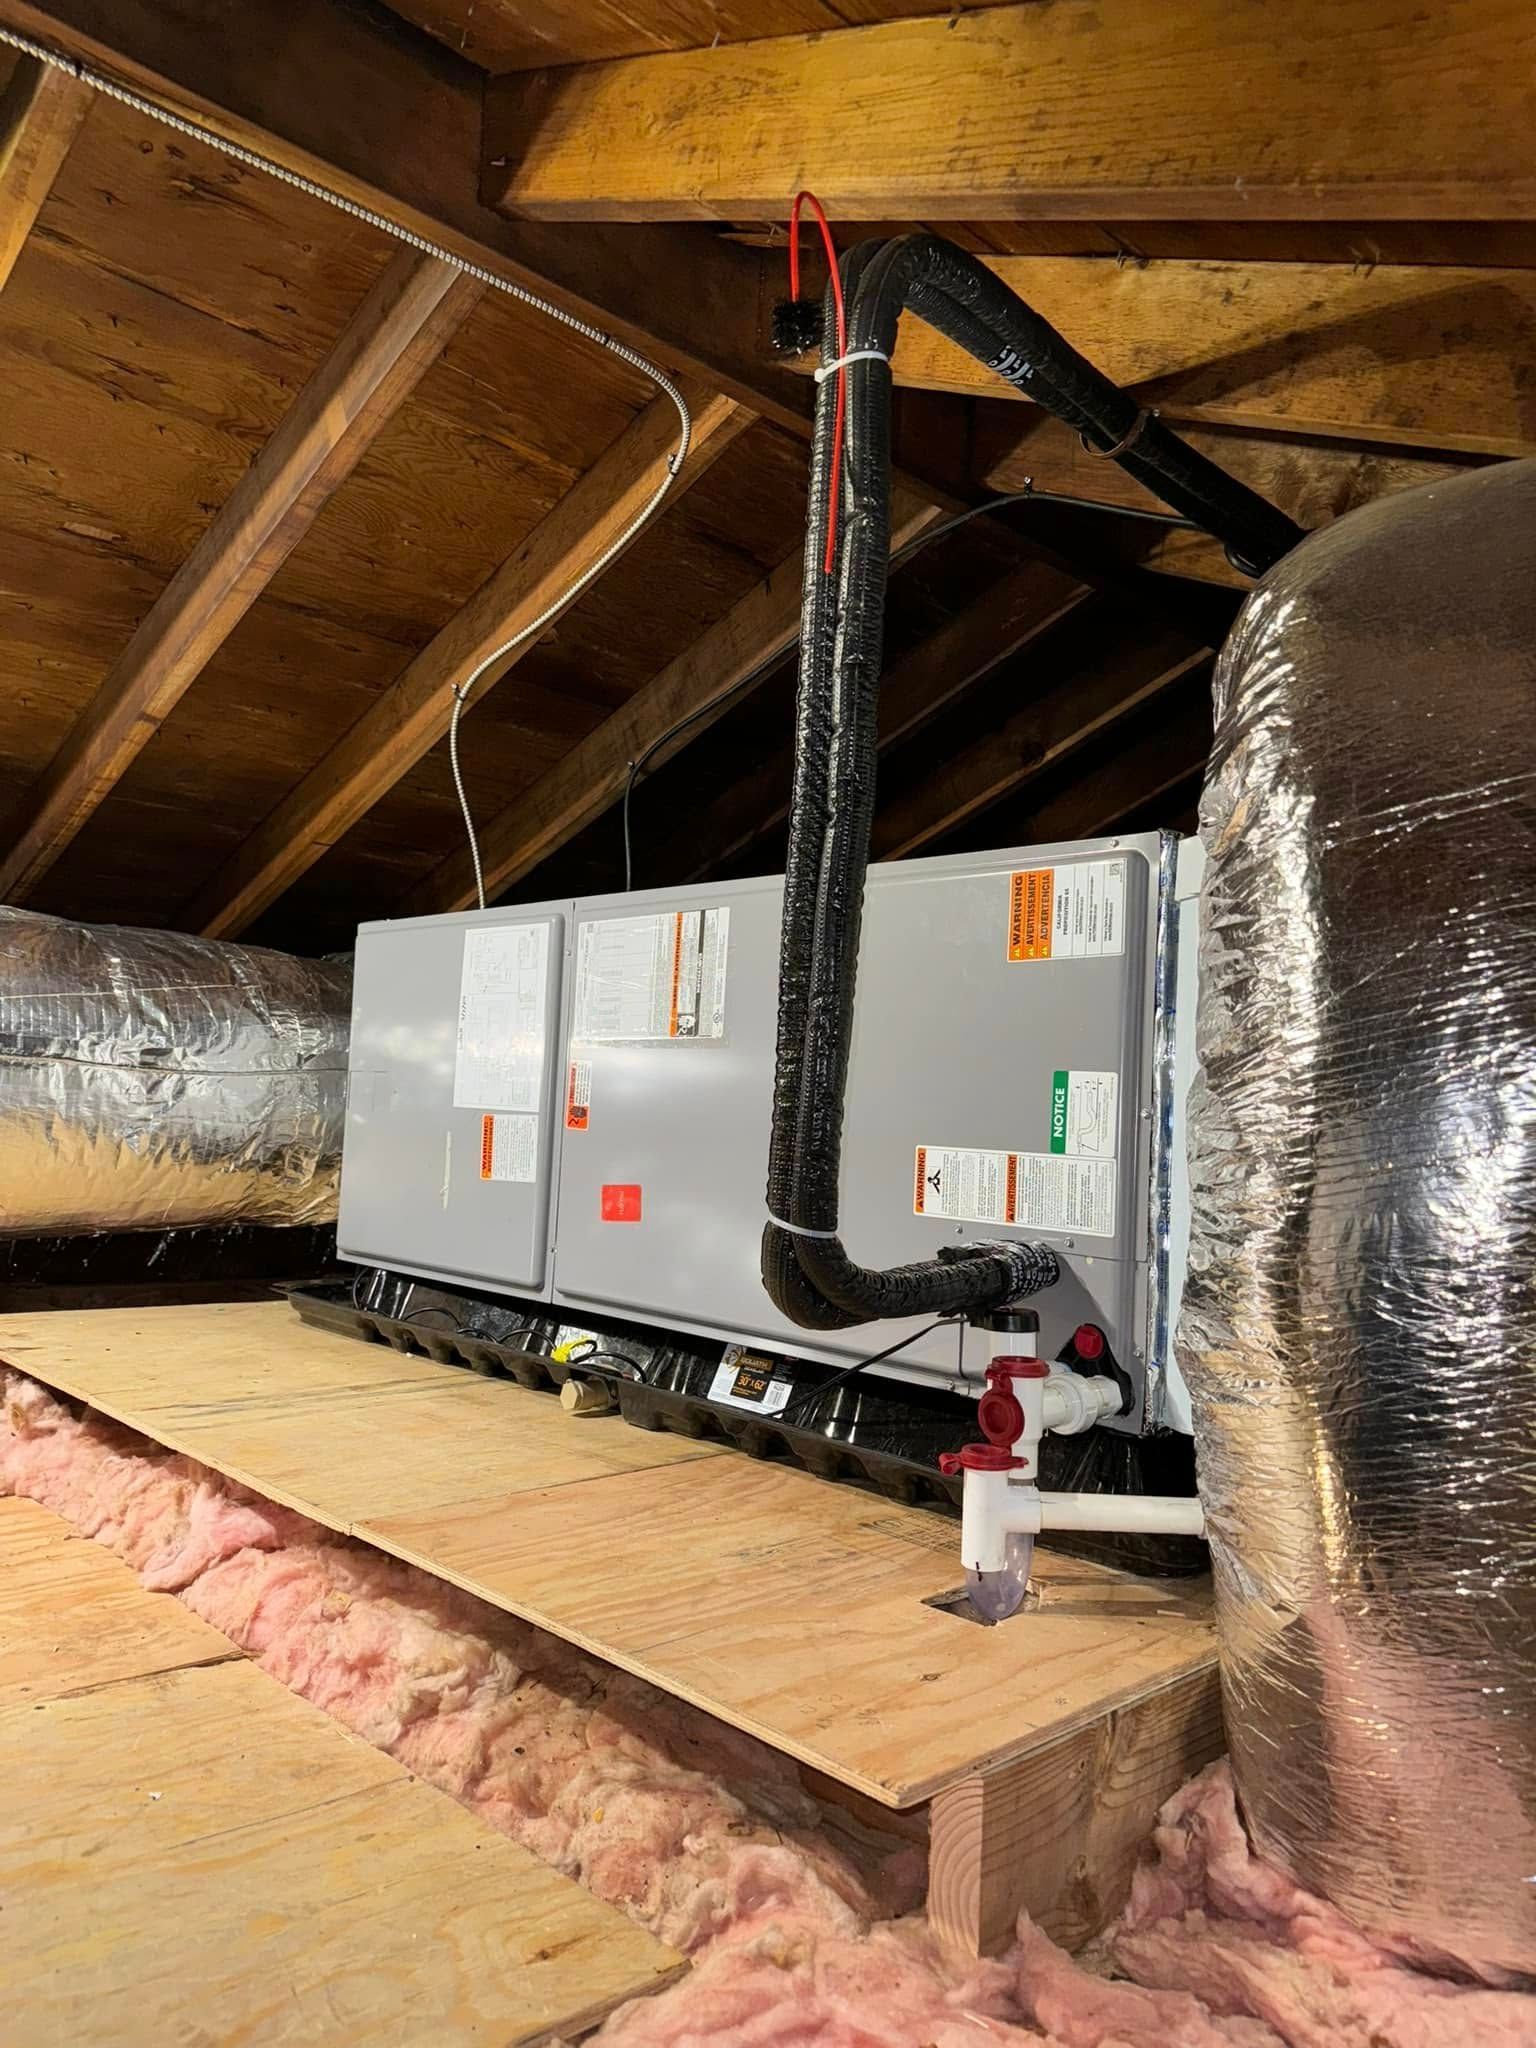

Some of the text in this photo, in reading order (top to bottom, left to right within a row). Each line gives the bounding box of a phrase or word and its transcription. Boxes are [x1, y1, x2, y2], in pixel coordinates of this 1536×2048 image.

[1013, 876, 1023, 945] WARNING
[1026, 874, 1036, 945] AVERTISSEMENT
[1040, 875, 1050, 940] ADVERTENCIA
[1053, 1088, 1065, 1137] NOTICE
[917, 1152, 926, 1200] WARNING
[1007, 1155, 1017, 1213] AVERTISSEMENT
